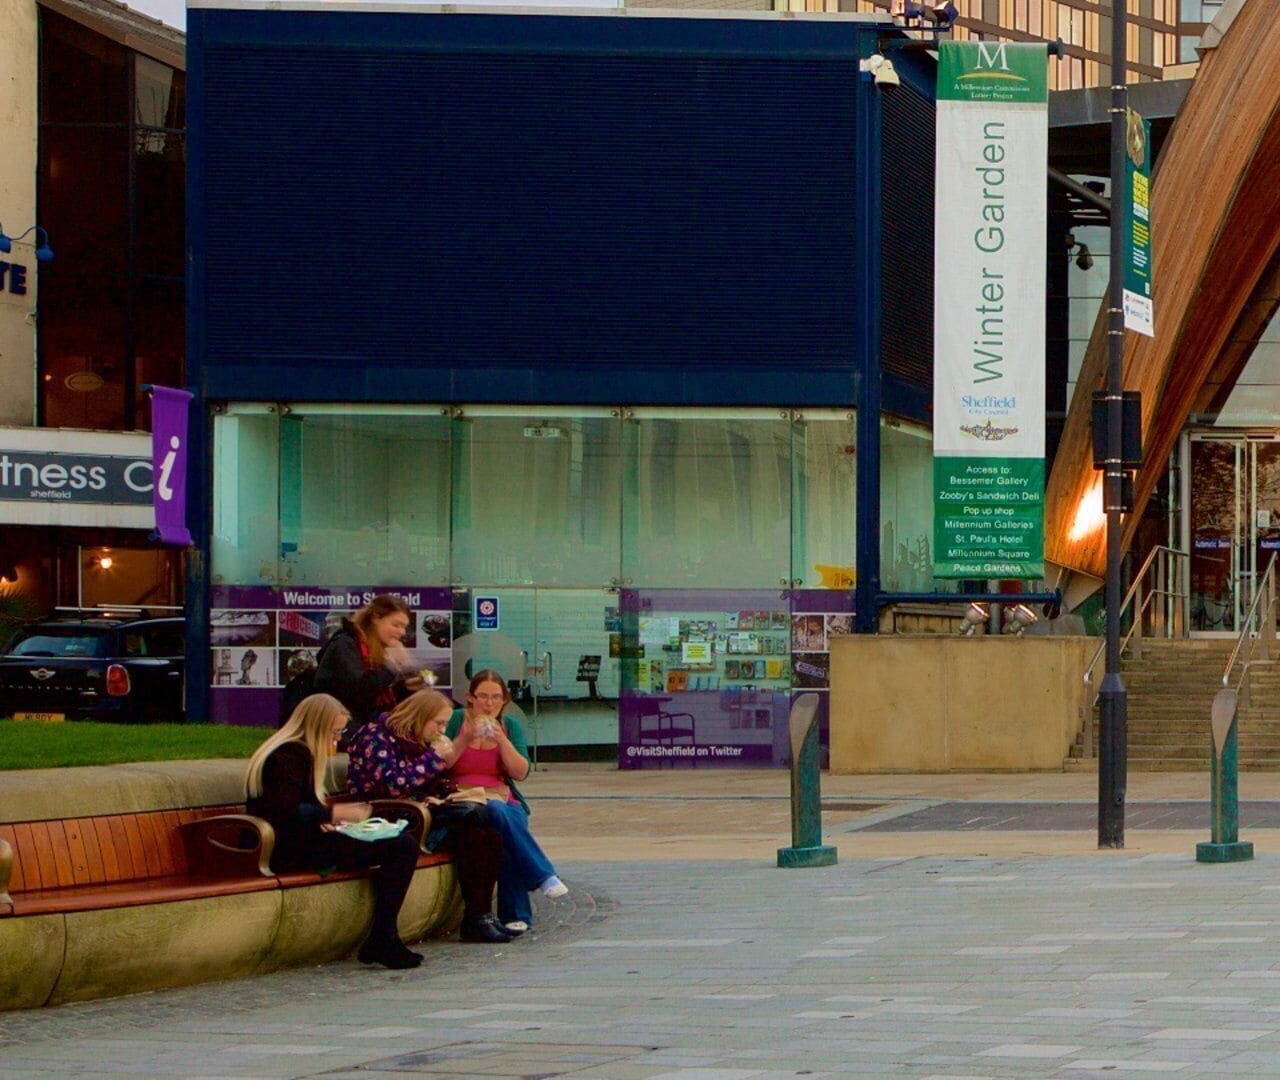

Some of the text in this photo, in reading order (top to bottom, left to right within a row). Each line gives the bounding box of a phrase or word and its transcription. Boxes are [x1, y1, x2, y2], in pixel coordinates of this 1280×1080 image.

[974, 42, 1010, 71] M
[974, 121, 1005, 253] Garden
[973, 267, 1004, 384] Winter
[961, 395, 1016, 408] Sheffield
[966, 466, 998, 474] Access
[950, 476, 1029, 486] Bessemer Gallery
[30, 490, 72, 499] sheffield
[939, 491, 1040, 501] Zooby's Sandwich Deli
[963, 506, 1014, 516] Pop up shop
[945, 520, 1034, 529] Millennium Galleries
[970, 534, 997, 543] Paul's
[999, 535, 1024, 543] Hotel
[948, 549, 1030, 559] Millennium Square
[953, 563, 1021, 573] Peace Gardens
[283, 591, 421, 606] Welcome to Sfield
[626, 746, 743, 757] @VisitSheffield on Twitter
